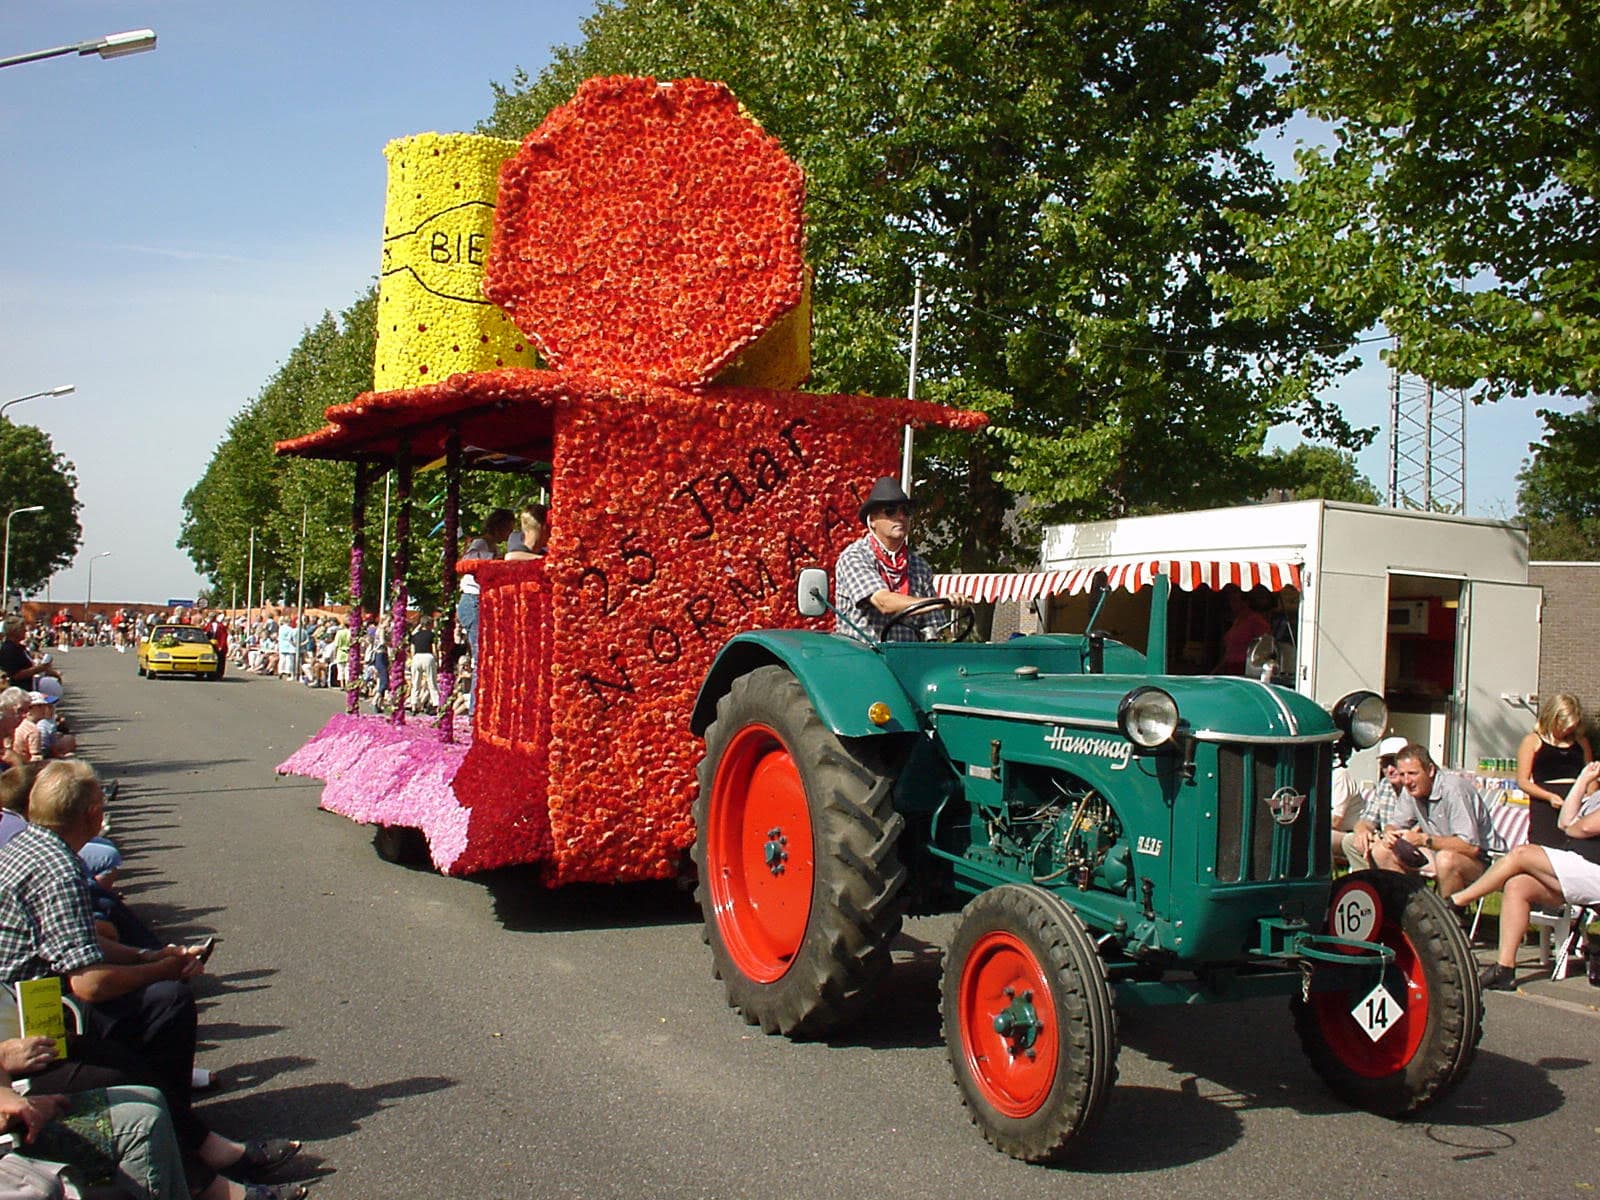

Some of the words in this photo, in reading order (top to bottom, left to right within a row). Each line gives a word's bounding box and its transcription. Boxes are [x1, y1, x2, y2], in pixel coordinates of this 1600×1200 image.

[431, 231, 485, 266] BIE
[580, 530, 657, 616] 25
[1044, 726, 1133, 770] Hanomag
[1337, 901, 1360, 934] 16
[1366, 997, 1388, 1029] 14
